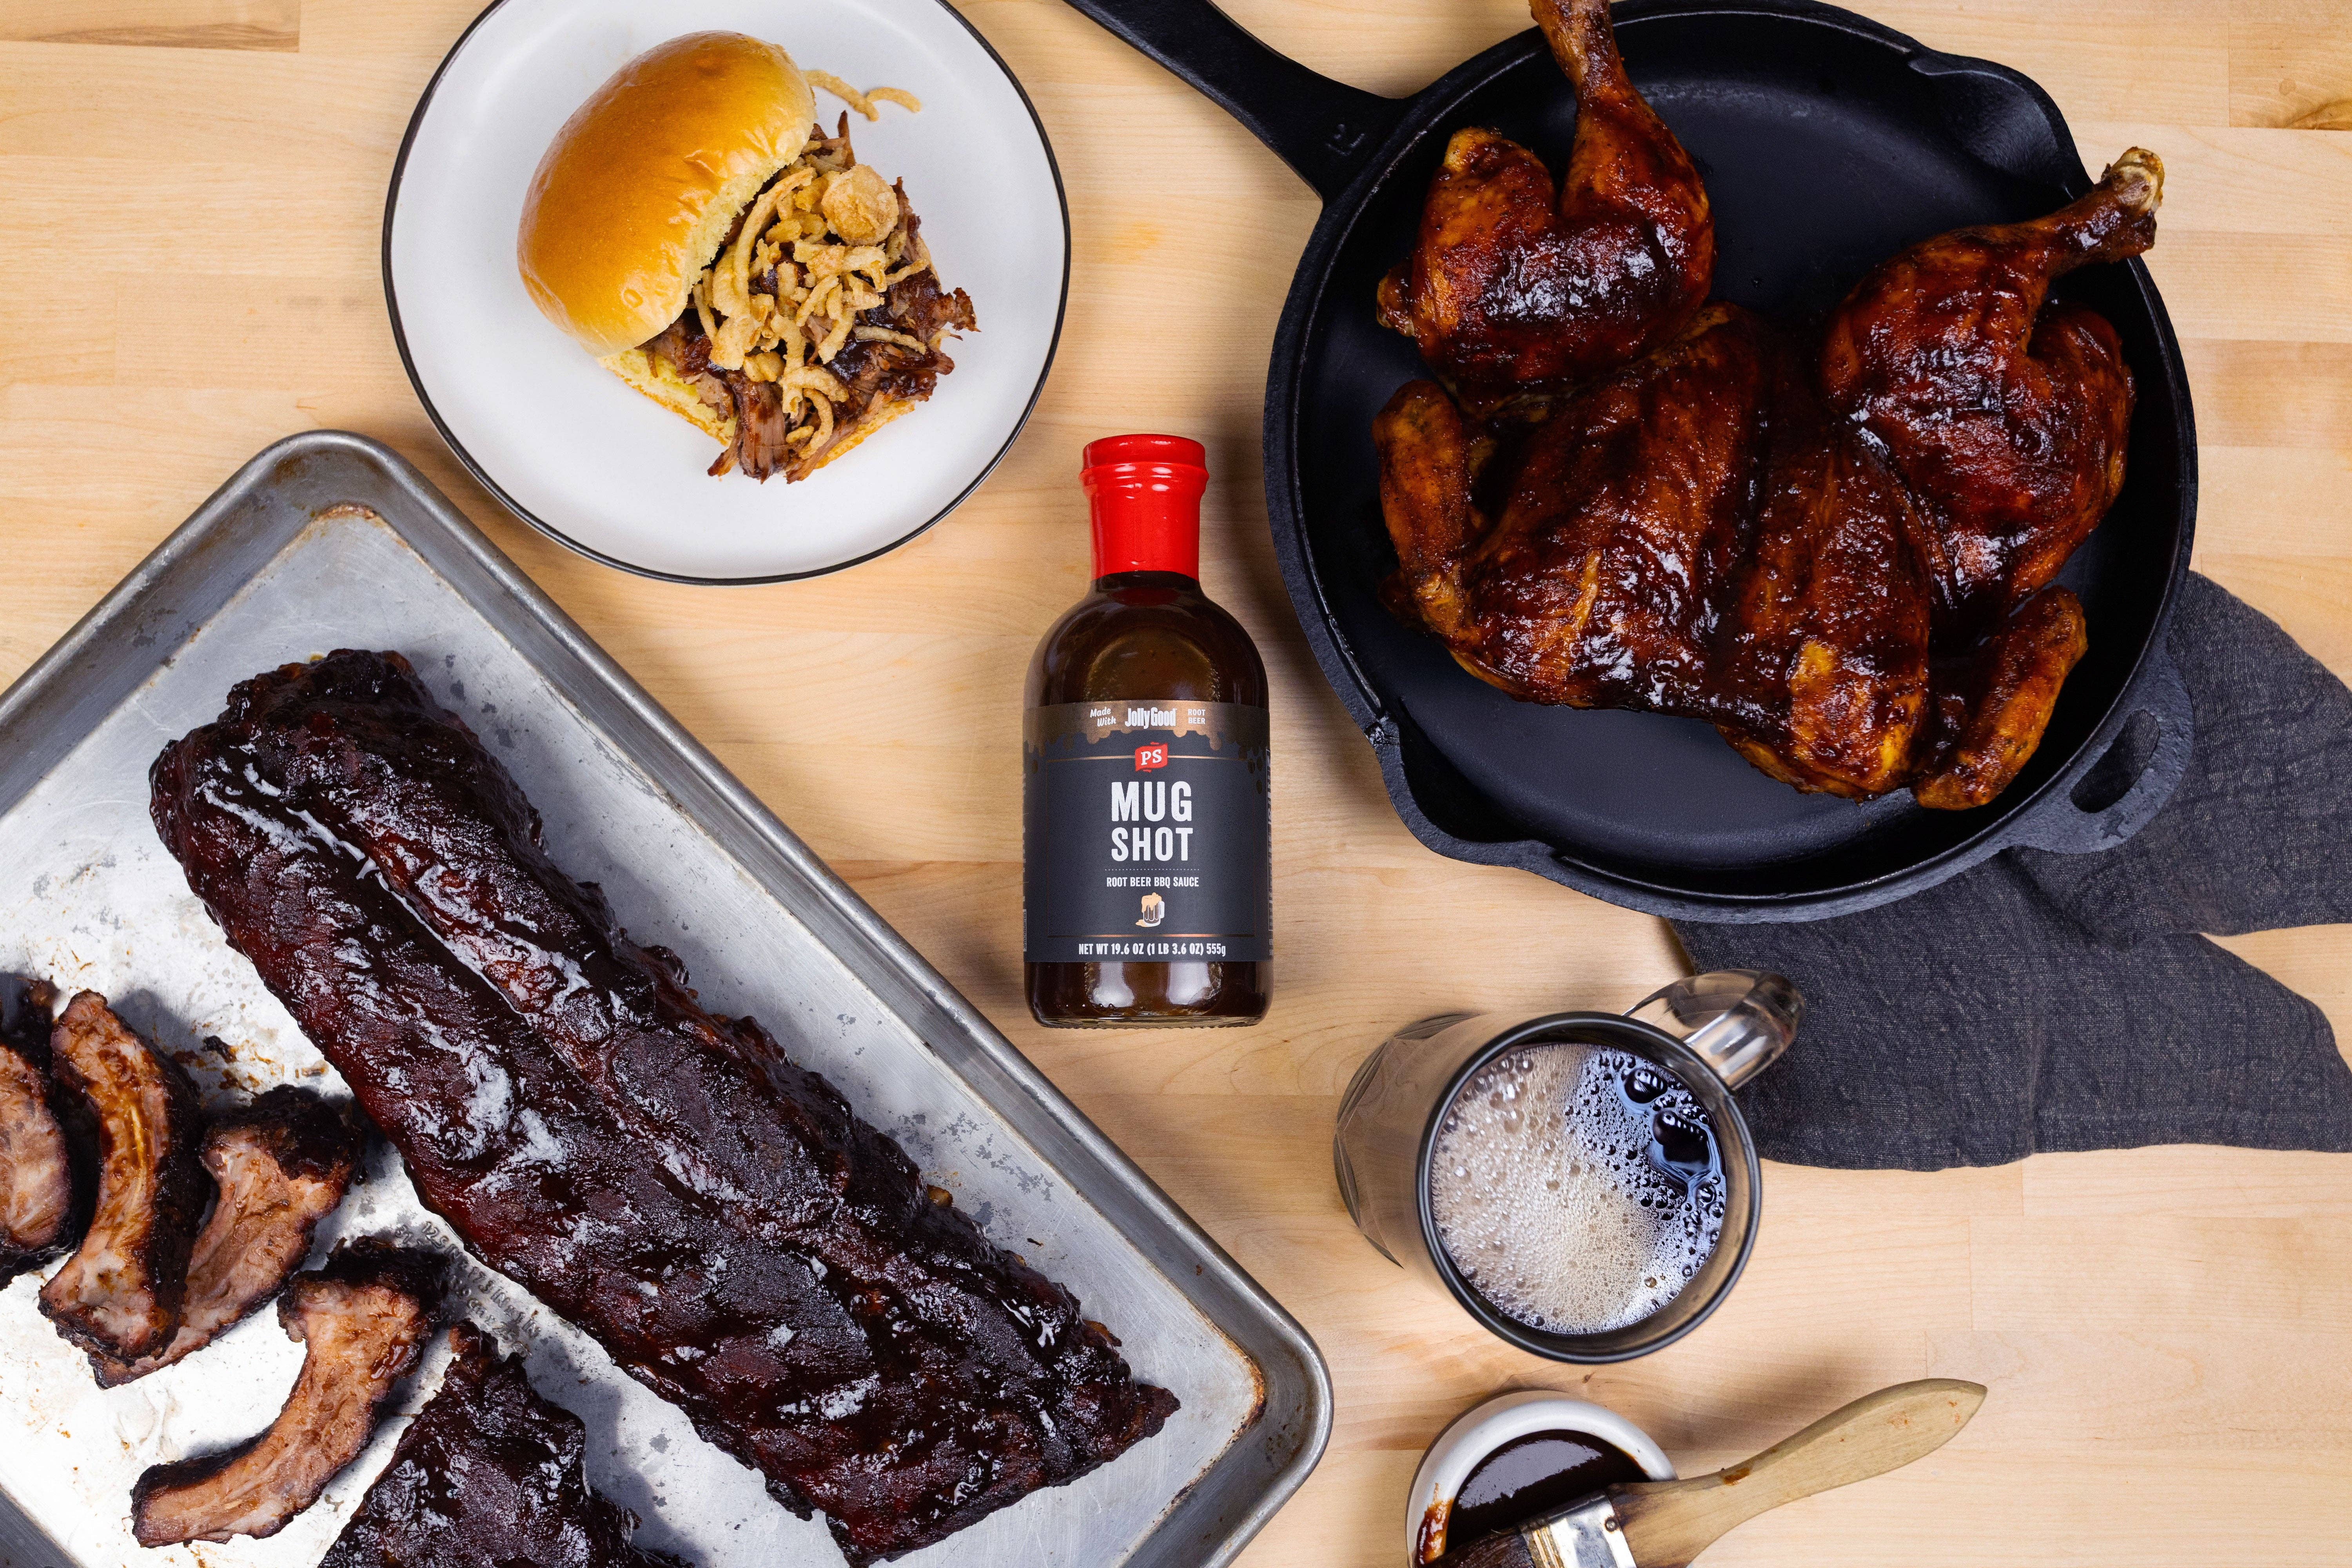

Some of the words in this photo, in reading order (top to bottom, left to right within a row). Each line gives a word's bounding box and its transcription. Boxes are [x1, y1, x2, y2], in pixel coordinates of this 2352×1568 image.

[1090, 707, 1111, 718] Made
[1097, 716, 1116, 727] With
[1141, 749, 1162, 766] PS
[1111, 780, 1192, 822] MUG
[1111, 827, 1193, 862] SHOT
[1106, 877, 1128, 887] ROOT
[1130, 877, 1152, 887] BEER
[1154, 876, 1170, 889] BBQ
[1173, 876, 1200, 887] SAUCE
[1078, 943, 1094, 955] NET
[1096, 943, 1109, 955] WT
[1111, 943, 1130, 955] 19.6
[1132, 943, 1144, 955] OZ
[1147, 943, 1155, 956] (1
[1158, 943, 1169, 955] LB
[1172, 942, 1187, 955] 3.6
[1189, 942, 1204, 956] OZ)
[1206, 943, 1226, 957] 555g
